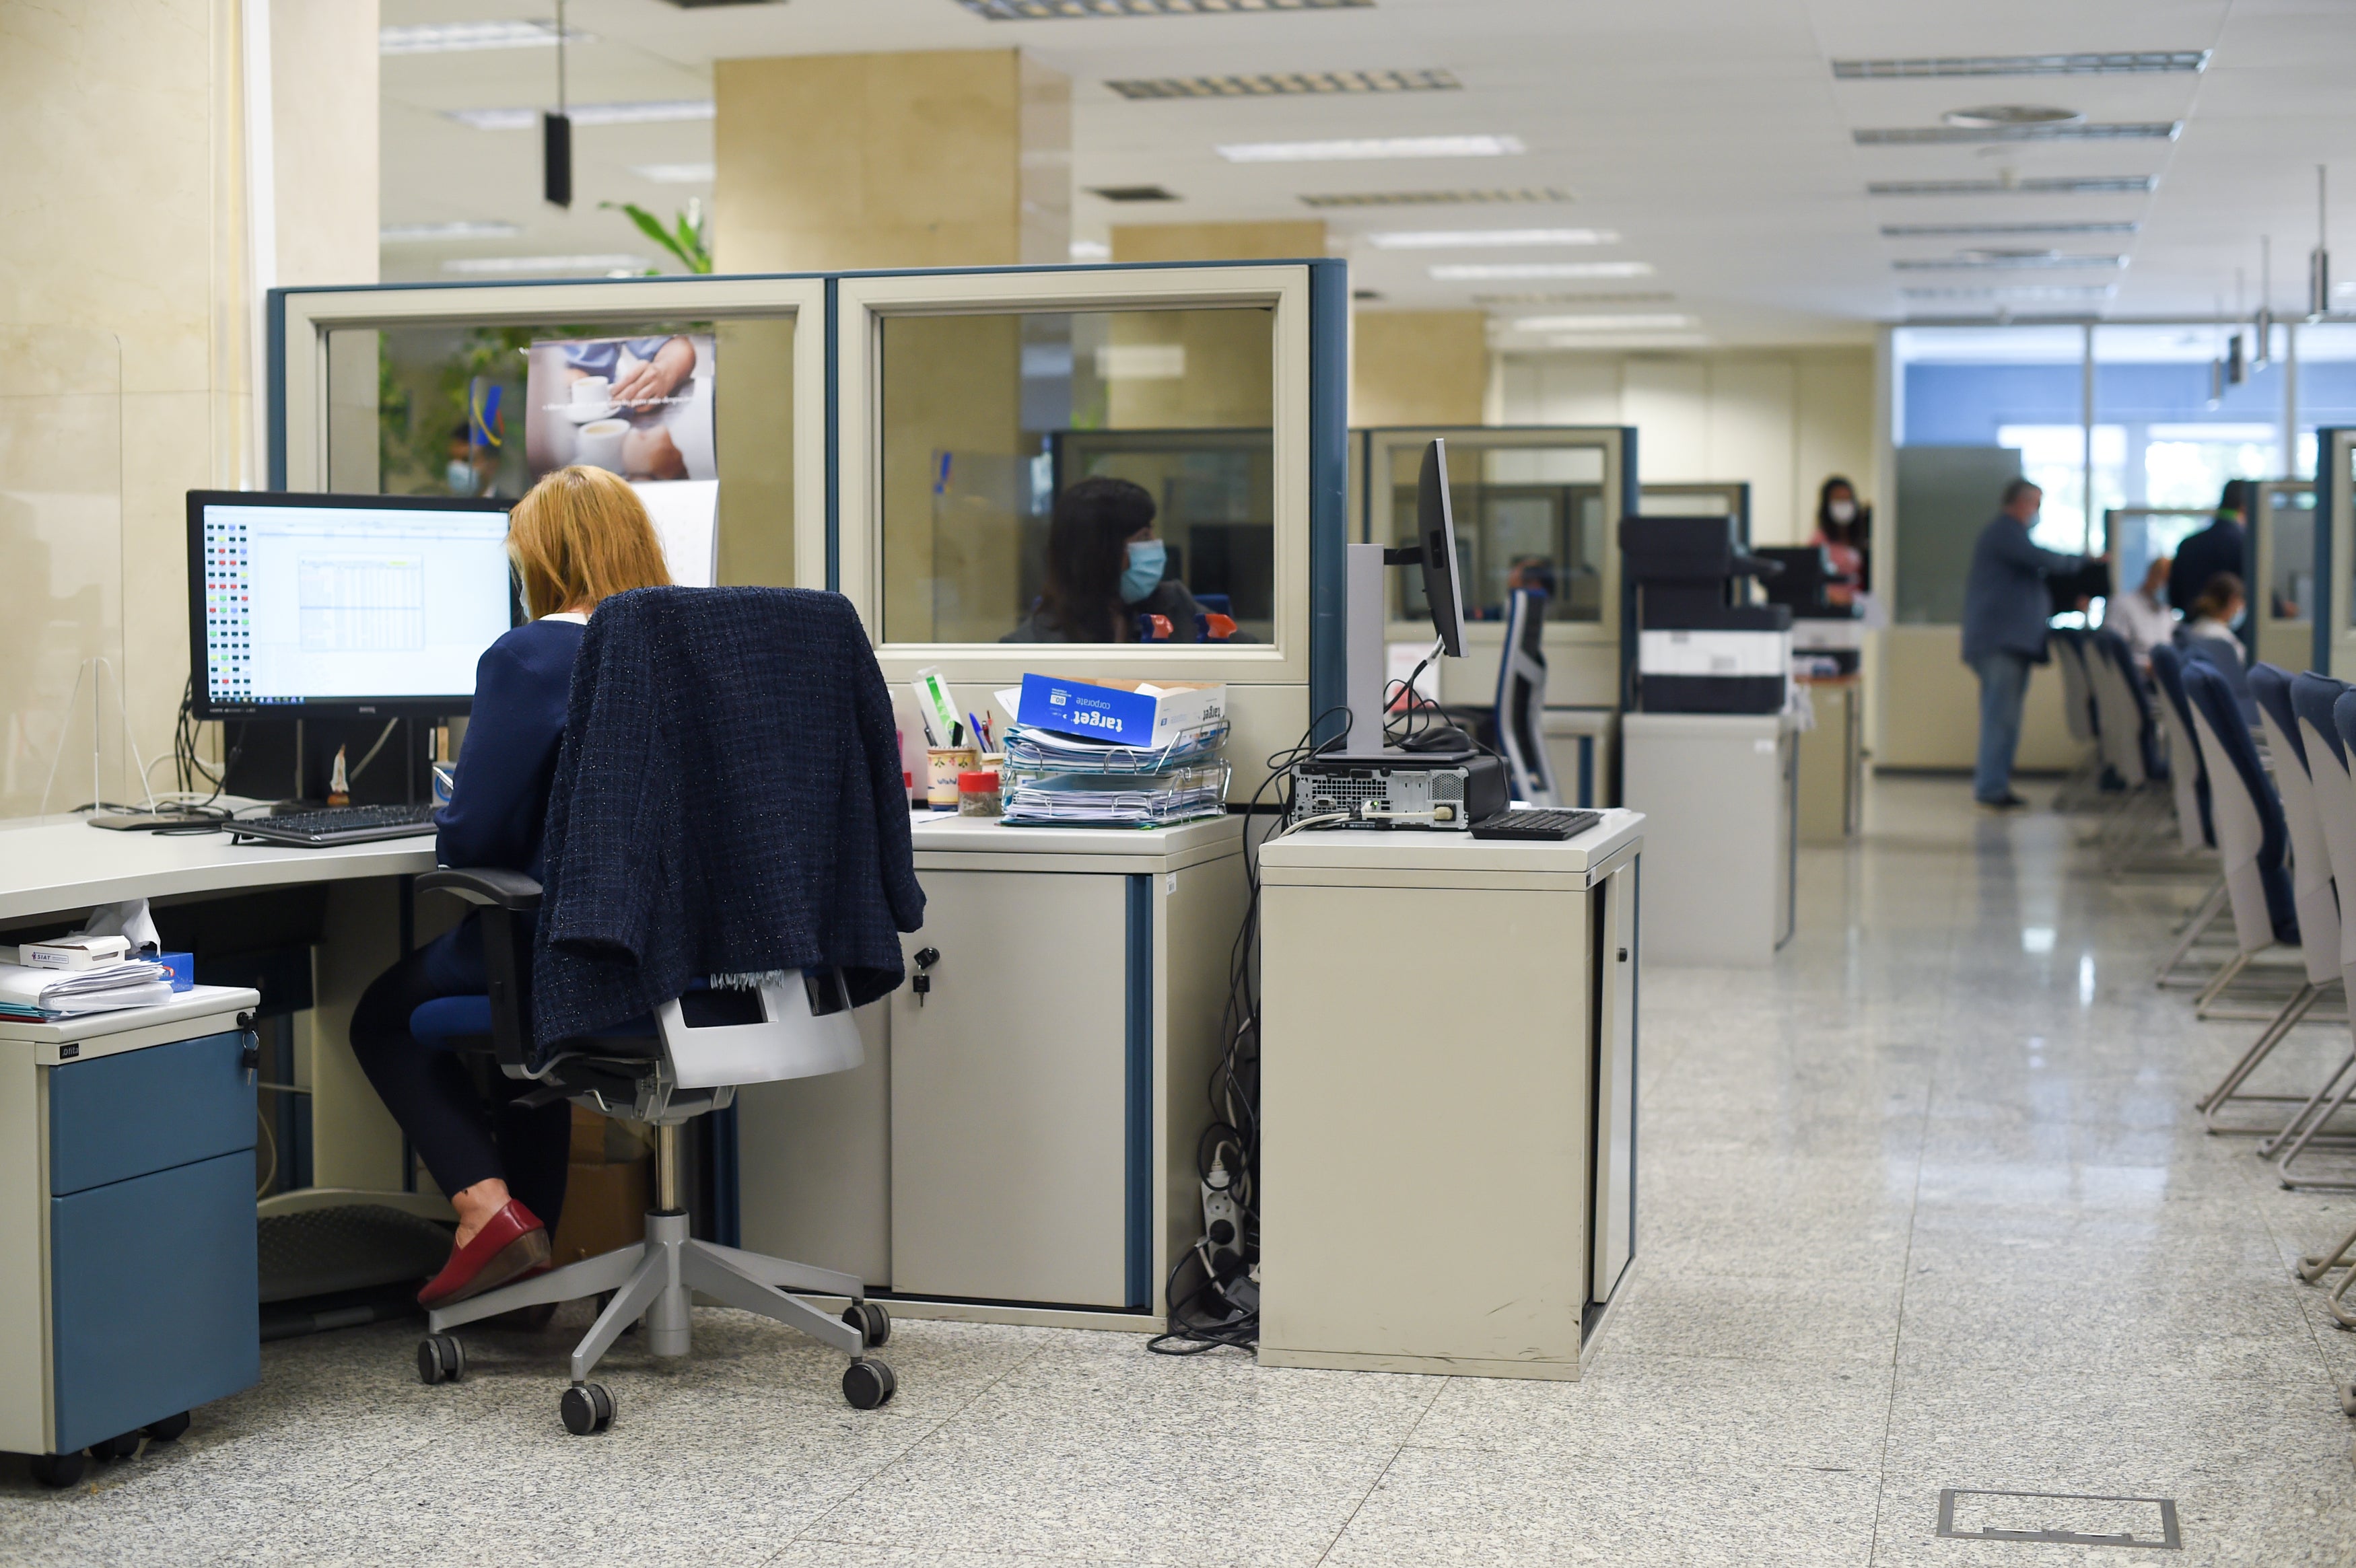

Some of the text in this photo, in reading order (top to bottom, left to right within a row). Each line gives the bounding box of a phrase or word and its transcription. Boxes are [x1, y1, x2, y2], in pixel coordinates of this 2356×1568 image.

[1076, 697, 1111, 710] corporate
[1203, 705, 1220, 721] target
[1073, 711, 1123, 733] target
